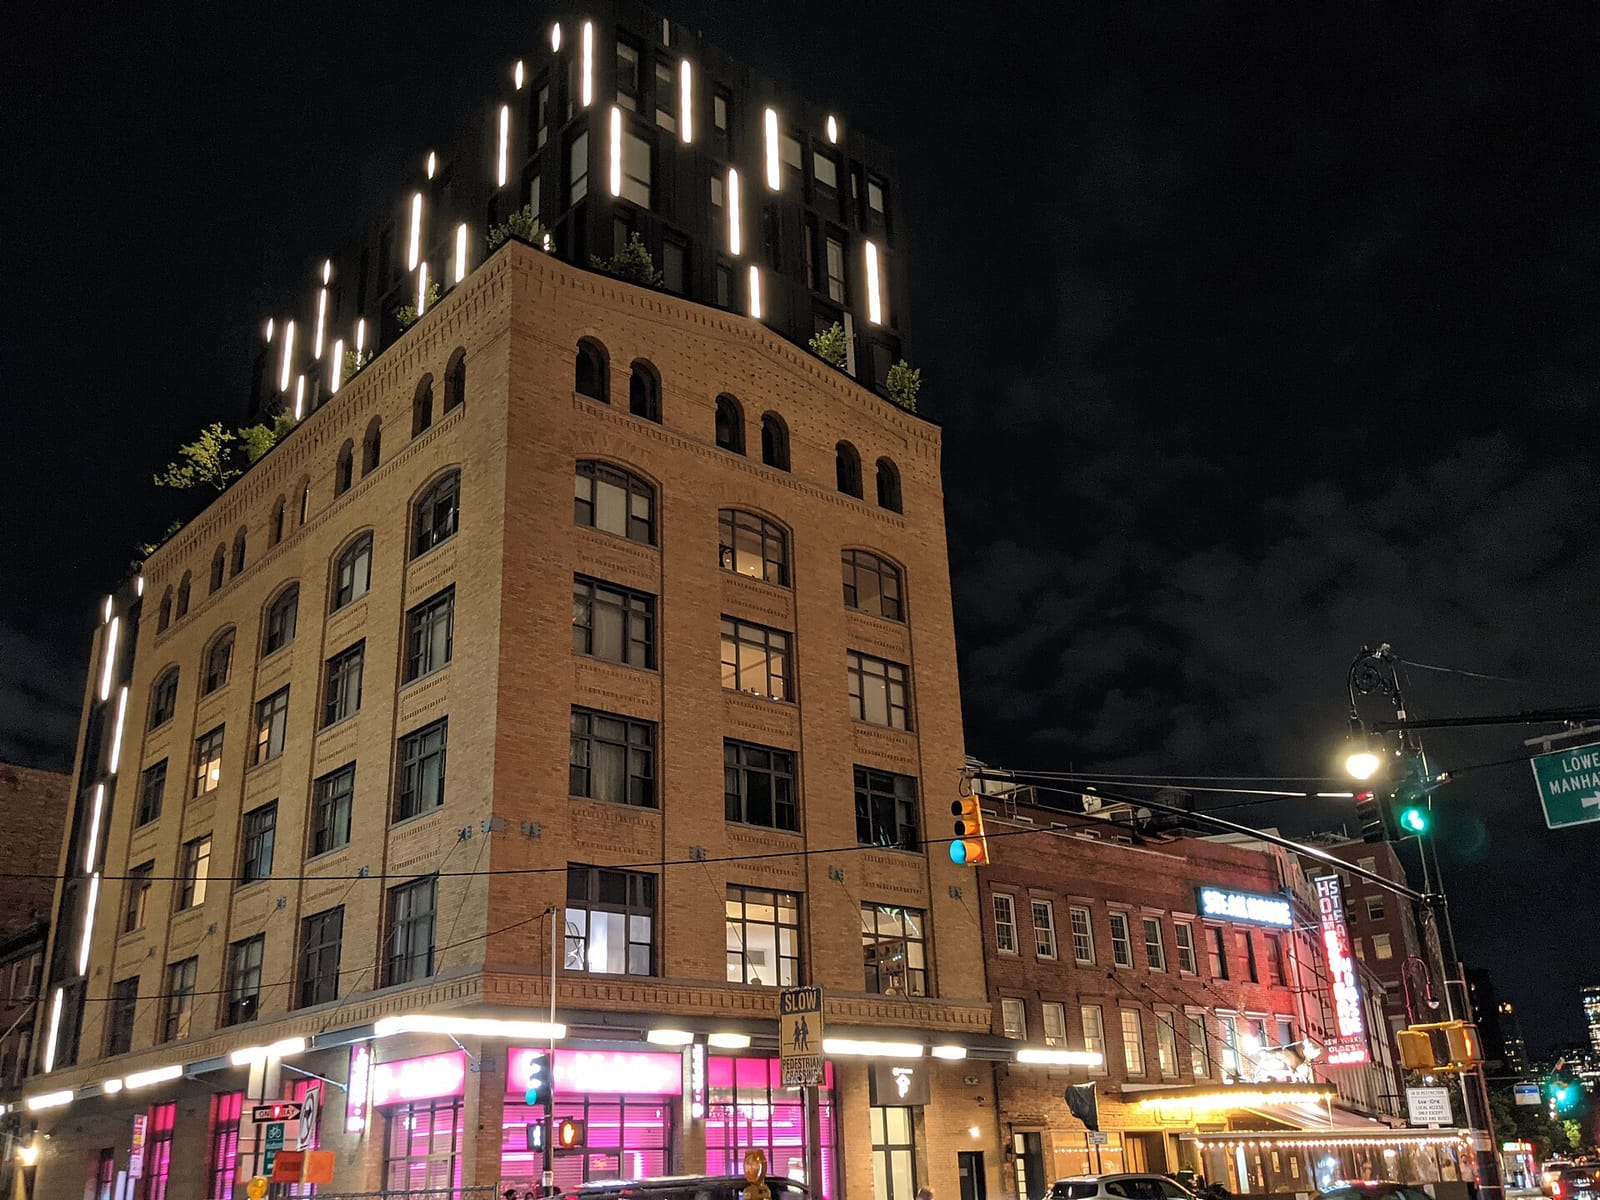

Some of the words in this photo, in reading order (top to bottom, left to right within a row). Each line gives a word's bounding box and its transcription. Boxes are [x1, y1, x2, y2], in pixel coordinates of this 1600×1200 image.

[1562, 752, 1600, 773] LOWE
[1549, 771, 1600, 795] MANHA
[785, 991, 817, 1012] SLOW
[1328, 1044, 1361, 1053] OLDEST
[783, 1058, 820, 1070] PEDESTRIAN
[786, 1069, 818, 1081] CROSSING
